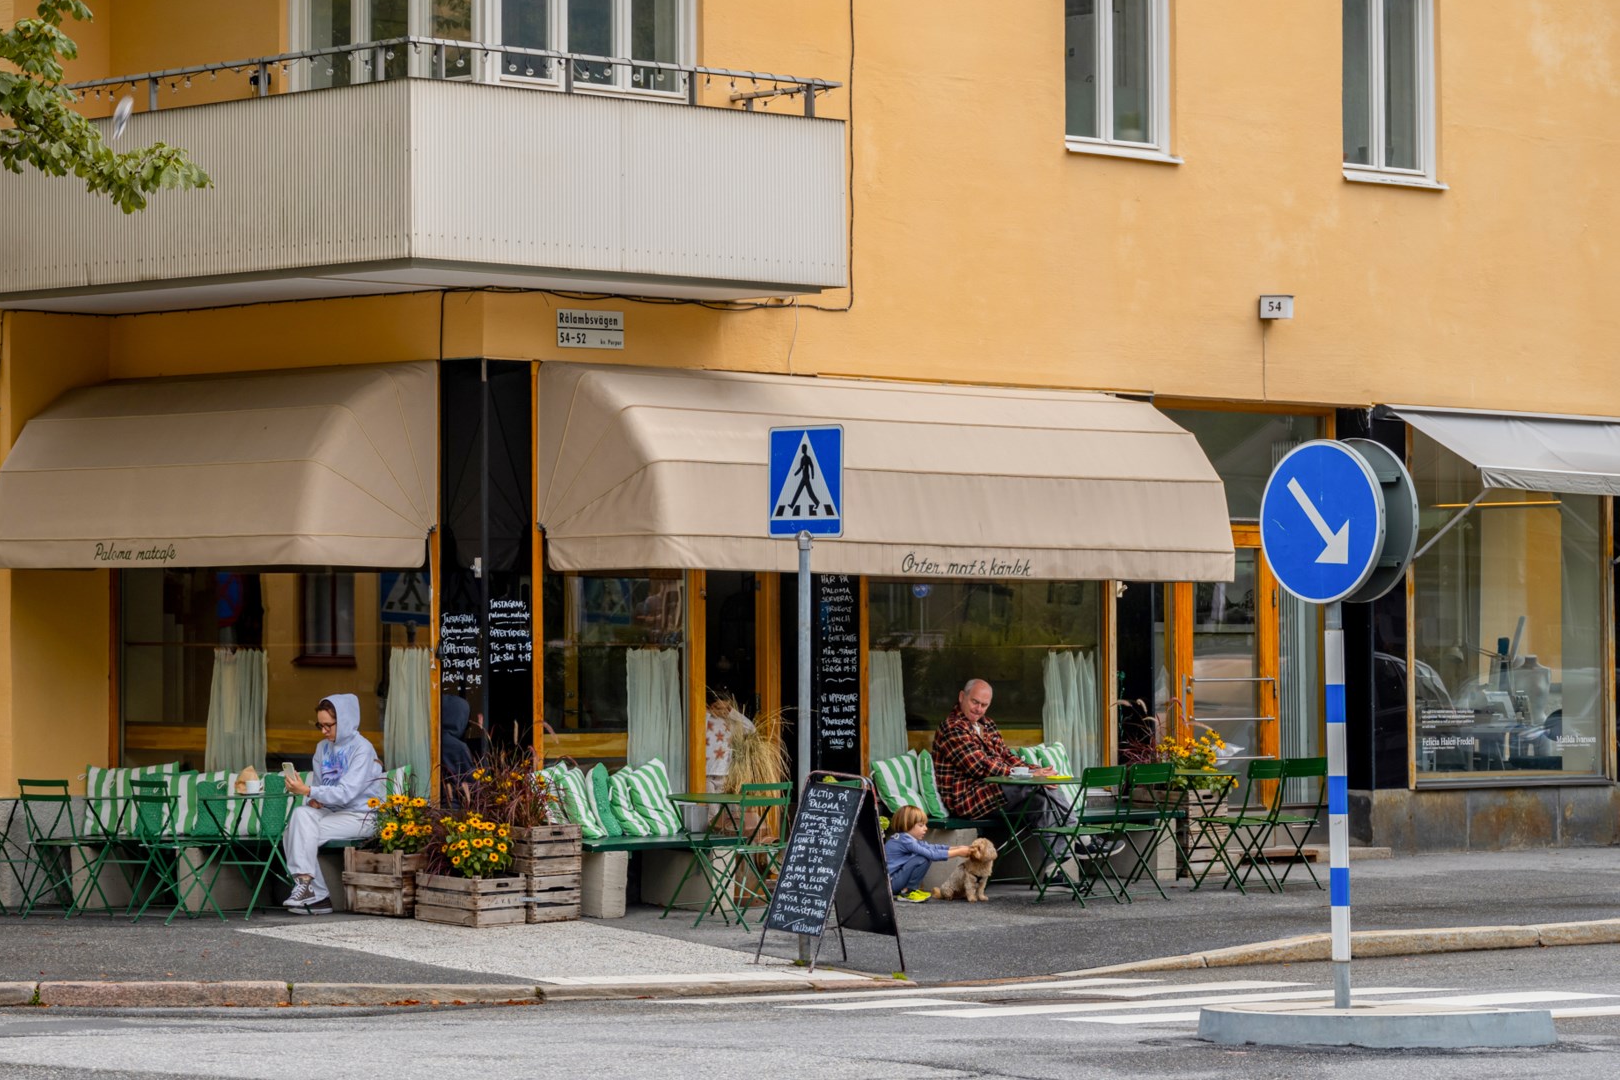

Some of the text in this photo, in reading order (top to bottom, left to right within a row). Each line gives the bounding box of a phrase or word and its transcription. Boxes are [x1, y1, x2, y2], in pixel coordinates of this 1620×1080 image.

[1268, 301, 1282, 312] 54
[559, 311, 619, 328] Rålambsvägen
[559, 331, 587, 344] 54-52
[93, 542, 132, 561] Paloma
[946, 559, 977, 576] mat
[979, 560, 988, 576] &
[989, 557, 1031, 577] kärlek
[821, 586, 851, 595] PALOMA
[1422, 737, 1440, 746] Felicia
[808, 788, 850, 801] ALLTID PÅ
[785, 872, 806, 882] SOPPA
[799, 882, 823, 892] SALLAD
